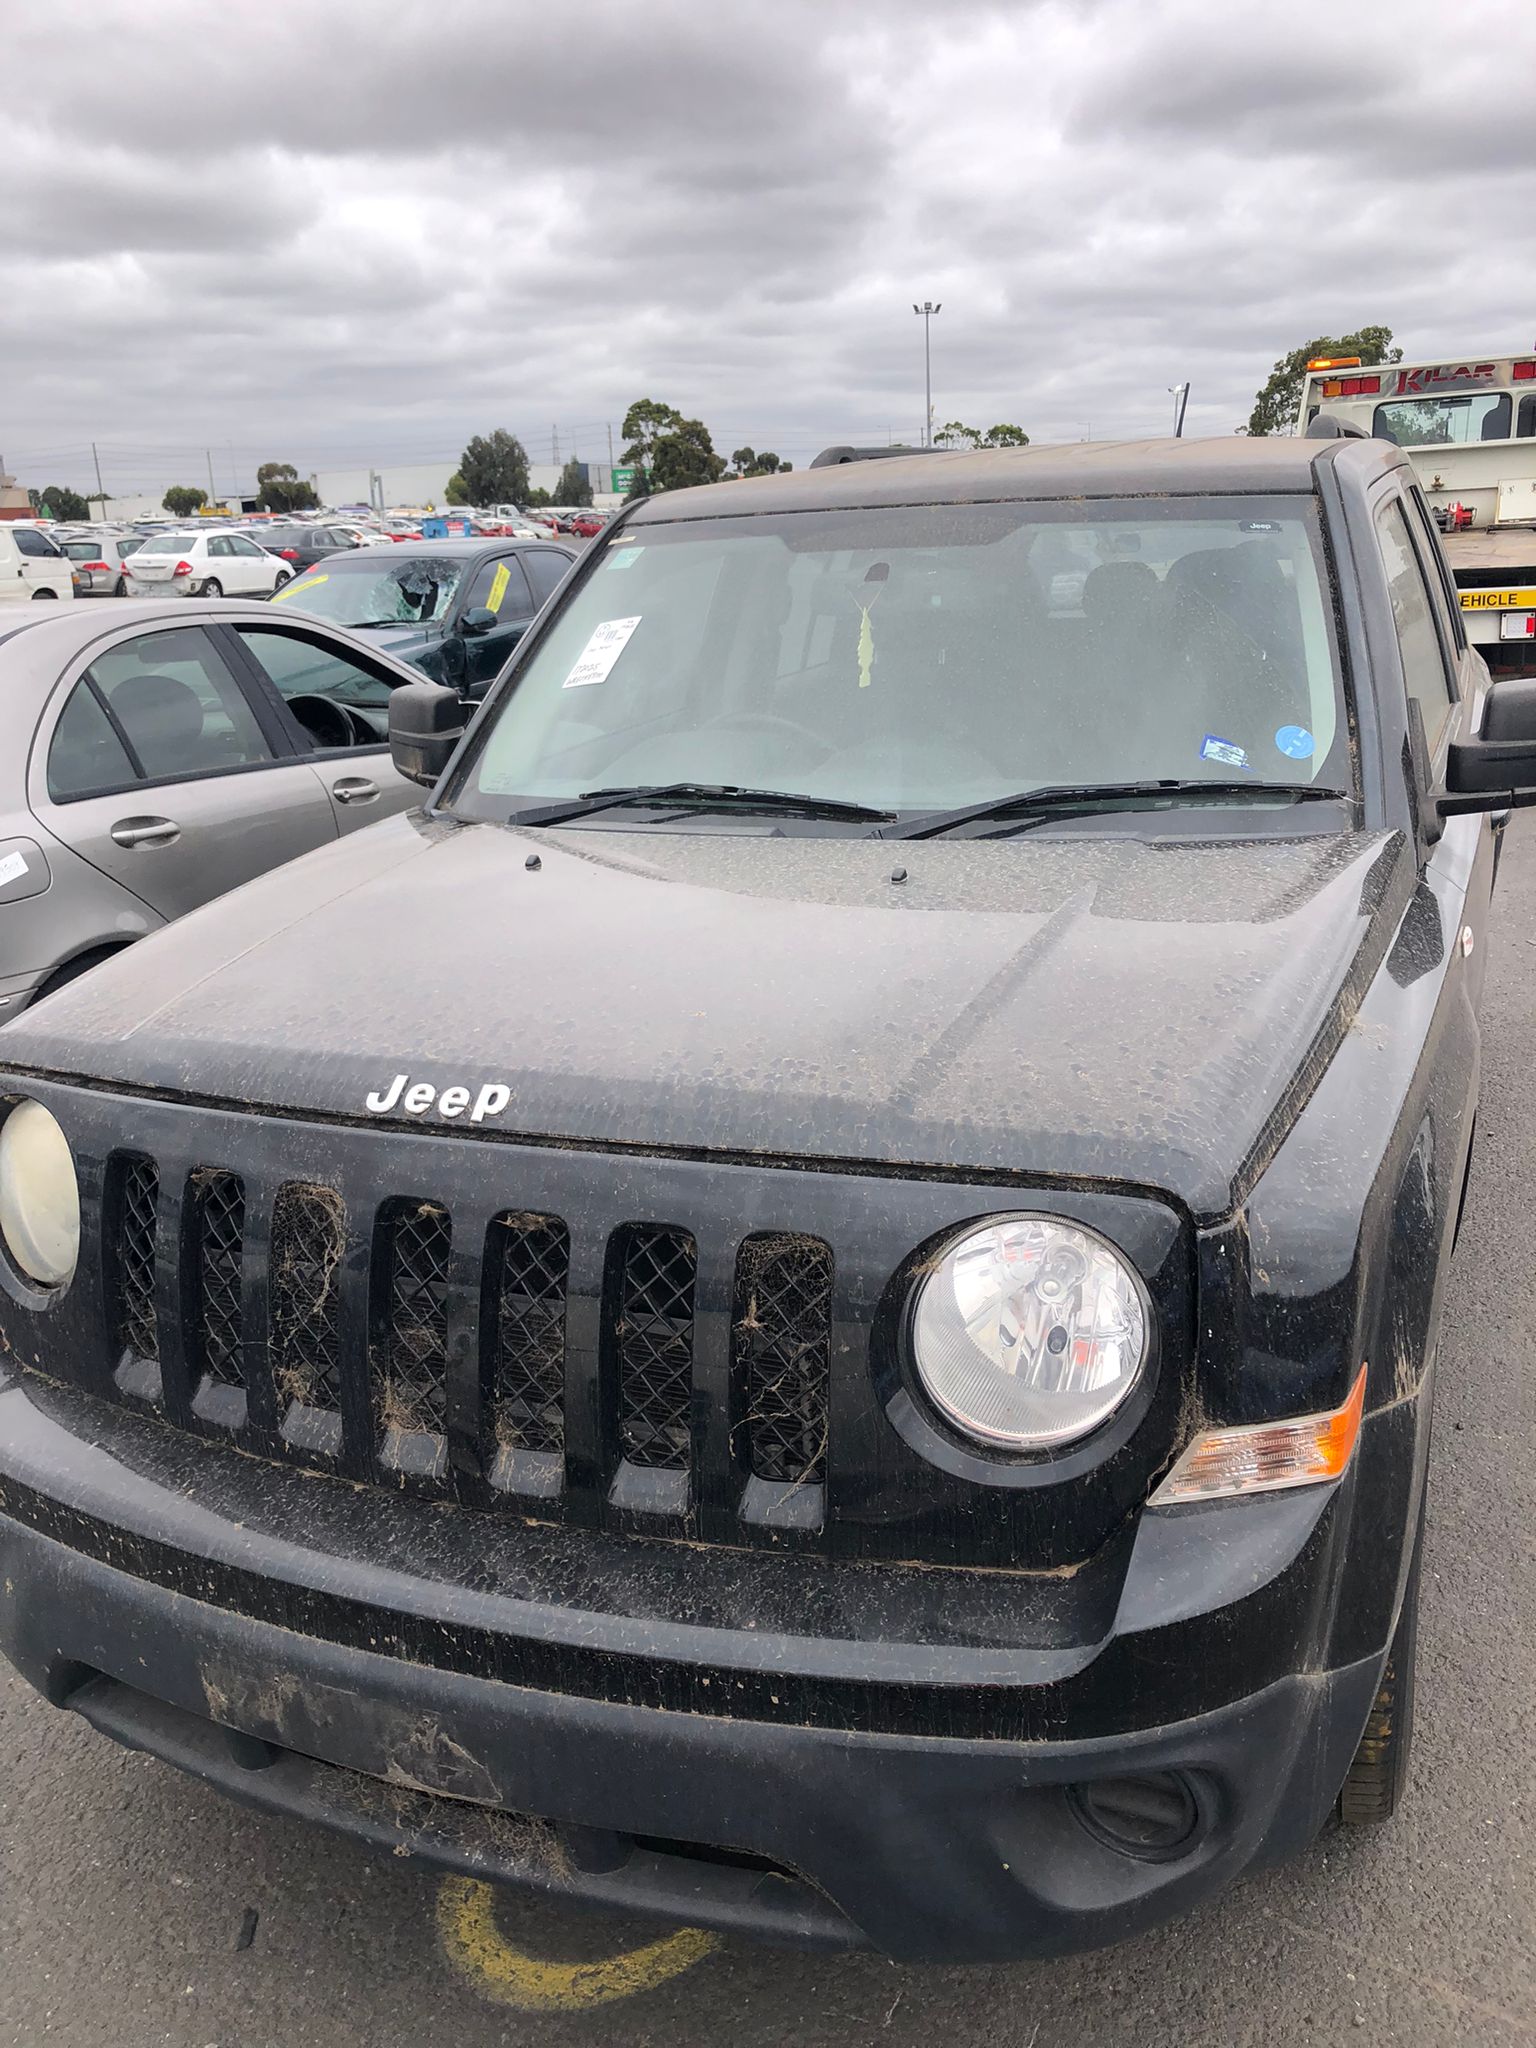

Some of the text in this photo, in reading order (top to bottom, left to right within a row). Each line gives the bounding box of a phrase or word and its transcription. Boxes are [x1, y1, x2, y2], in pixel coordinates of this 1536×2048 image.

[1397, 364, 1496, 392] KILAR
[1460, 593, 1518, 607] EHICLE
[365, 1074, 511, 1123] Jeep
